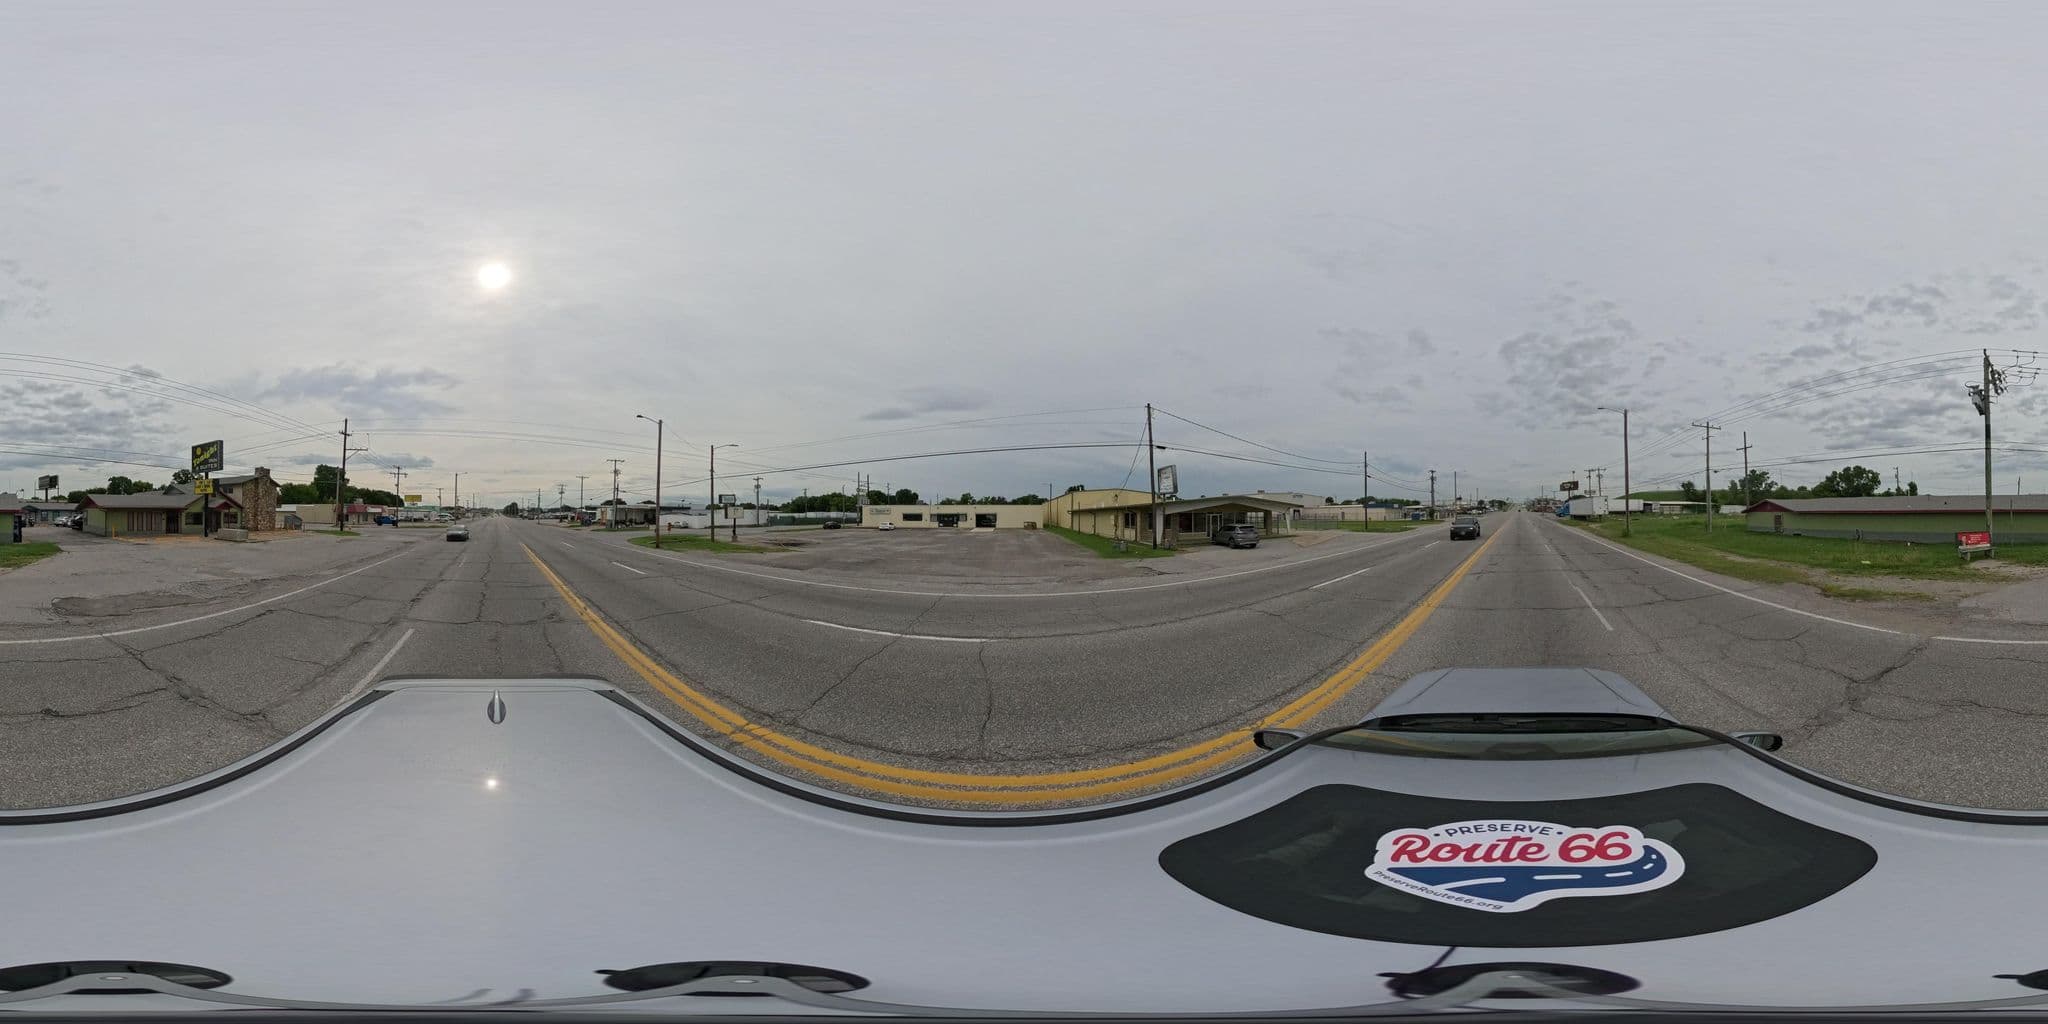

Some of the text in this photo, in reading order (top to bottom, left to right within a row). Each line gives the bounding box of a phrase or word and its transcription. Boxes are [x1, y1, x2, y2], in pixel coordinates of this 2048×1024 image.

[1445, 823, 1553, 837] PRESERVE
[1390, 831, 1632, 864] Route 66
[1373, 869, 1504, 911] PreserveRoute66.org
